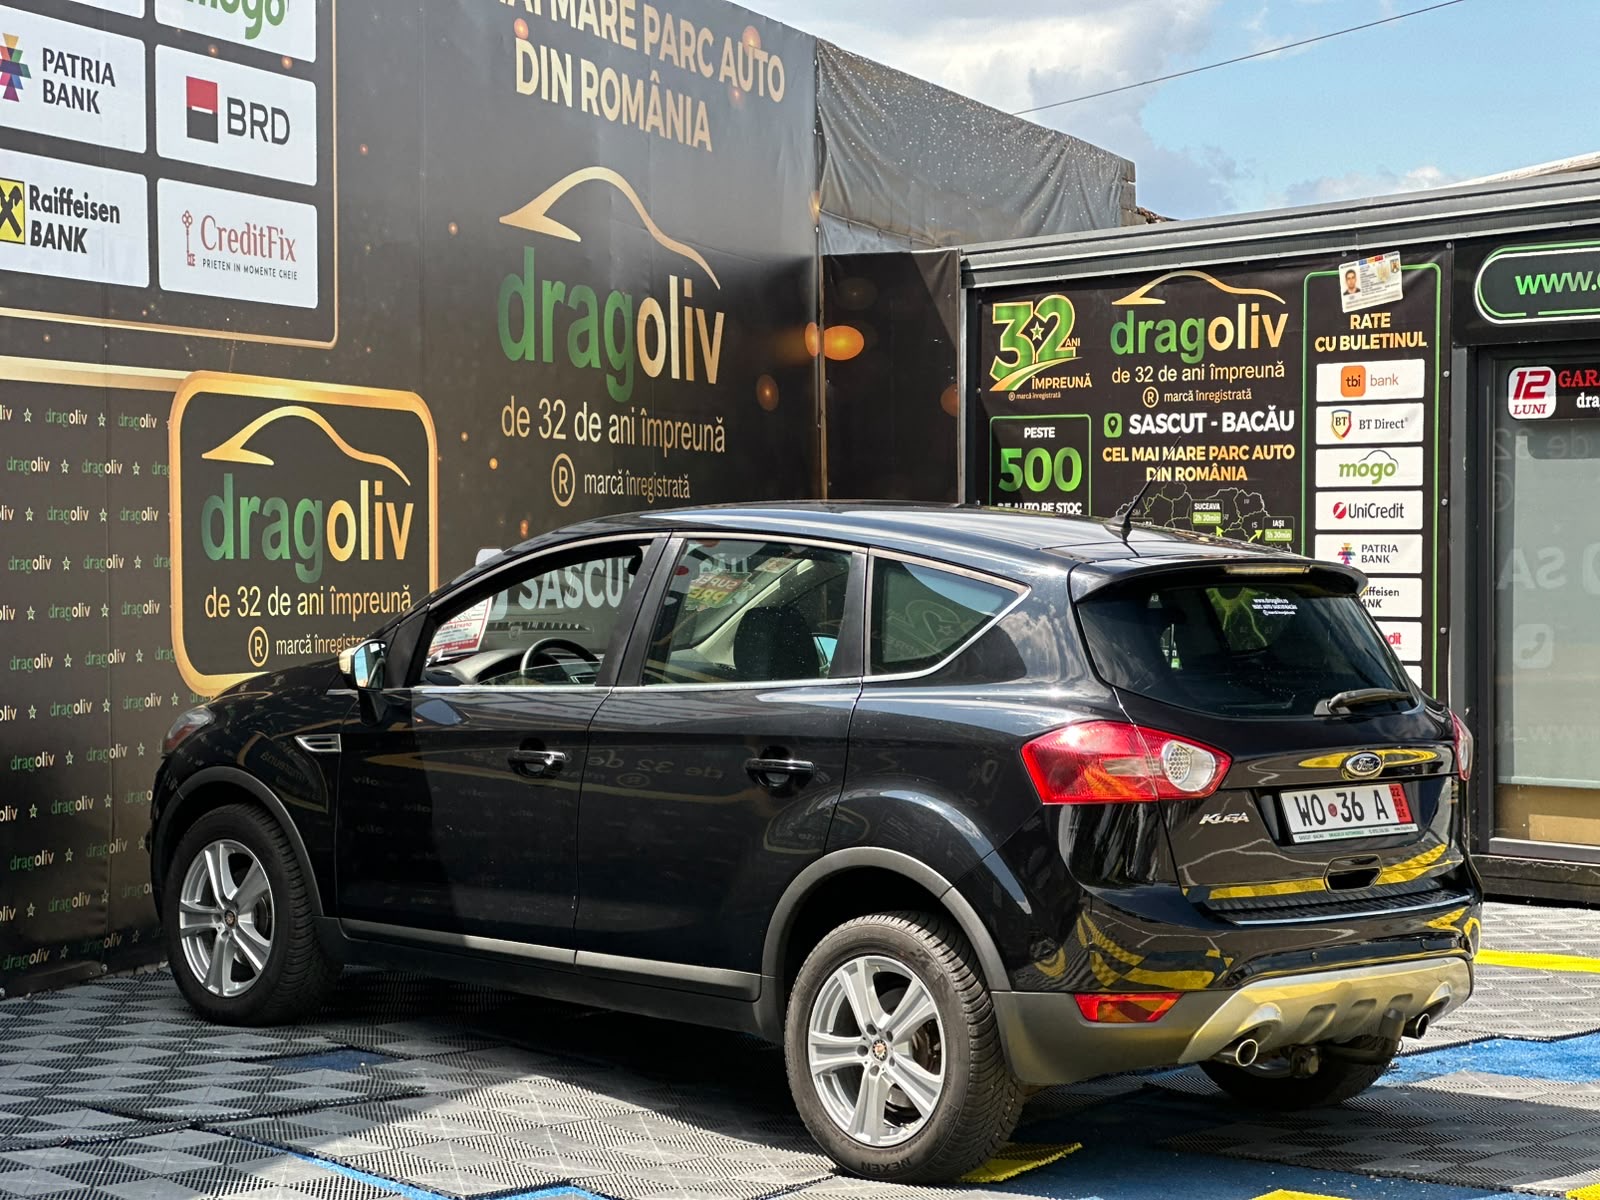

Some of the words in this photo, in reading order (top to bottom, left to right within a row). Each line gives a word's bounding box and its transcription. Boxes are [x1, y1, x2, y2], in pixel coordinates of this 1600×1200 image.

[186, 0, 285, 40] go
[551, 0, 637, 51] MARE
[643, 3, 714, 78] PARC
[719, 36, 785, 103] AUTO
[42, 47, 116, 88] PATRIA
[43, 79, 100, 114] BANK
[515, 37, 573, 108] DIN
[580, 58, 712, 152] ROMÂNIA
[227, 97, 290, 145] BRD
[29, 184, 121, 224] Raiffeisen
[30, 220, 87, 254] BANK
[200, 215, 296, 262] CreditFix
[203, 258, 231, 271] PRIETEN
[234, 263, 241, 273] IN
[244, 265, 276, 278] MOMENTE
[279, 270, 298, 281] CHEIE
[1515, 271, 1600, 295] www.
[498, 246, 725, 403] dragoliv
[1350, 312, 1391, 330] RATE
[990, 294, 1075, 382] 32
[1064, 337, 1081, 348] ANI
[1110, 302, 1289, 364] dragoliv
[1315, 337, 1337, 352] CU
[1340, 332, 1427, 351] BULETINUL
[1032, 373, 1092, 390] ÎMPREUNĂ
[1112, 367, 1130, 383] de
[1135, 366, 1153, 383] 32
[1158, 365, 1177, 382] de
[1182, 364, 1205, 381] ani
[1209, 361, 1285, 383] împreună
[1346, 374, 1361, 388] tbi
[1370, 373, 1399, 387] bank
[1164, 391, 1194, 402] marcă
[1195, 388, 1252, 403] înregistrată
[1513, 370, 1551, 400] 12
[1513, 404, 1547, 415] LUNI
[1576, 392, 1600, 410] dra
[45, 408, 87, 427] dragoliv
[118, 413, 157, 431] dragoliv
[501, 395, 530, 438] de
[538, 398, 567, 440] 32
[574, 402, 602, 443] de
[608, 407, 635, 445] ani
[641, 408, 725, 458] împreună
[1129, 412, 1207, 434] SASCUT
[1222, 405, 1295, 433] BACĂU
[1335, 416, 1348, 427] BT
[1359, 419, 1372, 430] BT
[1024, 427, 1055, 438] PESTE
[1102, 447, 1129, 462] CEL
[1132, 446, 1159, 461] MAI
[1163, 446, 1206, 461] MARE
[1208, 445, 1249, 461] PARC
[1252, 444, 1296, 460] AUTO
[6, 457, 50, 475] dragoliv
[82, 459, 123, 477] dragoliv
[999, 446, 1082, 493] 500
[1146, 466, 1172, 482] DIN
[1175, 463, 1248, 482] ROMÂNIA
[1339, 463, 1397, 485] mogo
[584, 469, 624, 496] marcă
[626, 470, 690, 504] înregistrată
[0, 505, 14, 521] liv
[47, 506, 89, 524] dragoliv
[120, 507, 159, 524] dragoliv
[1056, 502, 1082, 514] STOC
[1194, 502, 1221, 510] SUCEAVA
[1348, 502, 1404, 519] UniCredit
[201, 473, 414, 583] dragoliv
[1361, 543, 1398, 553] PATRIA
[1361, 554, 1390, 564] BANK
[8, 555, 51, 574] dragoliv
[83, 554, 124, 572] dragoliv
[1362, 586, 1400, 597] iffeisen
[48, 603, 90, 621] dragoliv
[121, 600, 160, 618] dragoliv
[205, 586, 230, 618] de
[237, 586, 261, 617] 32
[267, 586, 291, 616] de
[297, 586, 324, 615] ani
[329, 585, 411, 622] împreună
[1361, 598, 1382, 608] ANK
[276, 635, 312, 656] marcă
[10, 654, 53, 673] dragoliv
[85, 649, 126, 668] dragoliv
[50, 699, 92, 718] dragoliv
[122, 693, 161, 711] dragoliv
[10, 752, 55, 772] dragoliv
[86, 744, 128, 763] dragoliv
[51, 796, 94, 815] dragoliv
[1294, 794, 1326, 827] WO
[1336, 791, 1364, 823] 36
[1375, 790, 1389, 820] A
[1199, 811, 1249, 824] KUGA
[10, 850, 54, 871] dragoliv
[86, 838, 128, 858] dragoliv
[48, 892, 91, 912] dragoliv
[3, 949, 50, 970] dragoliv
